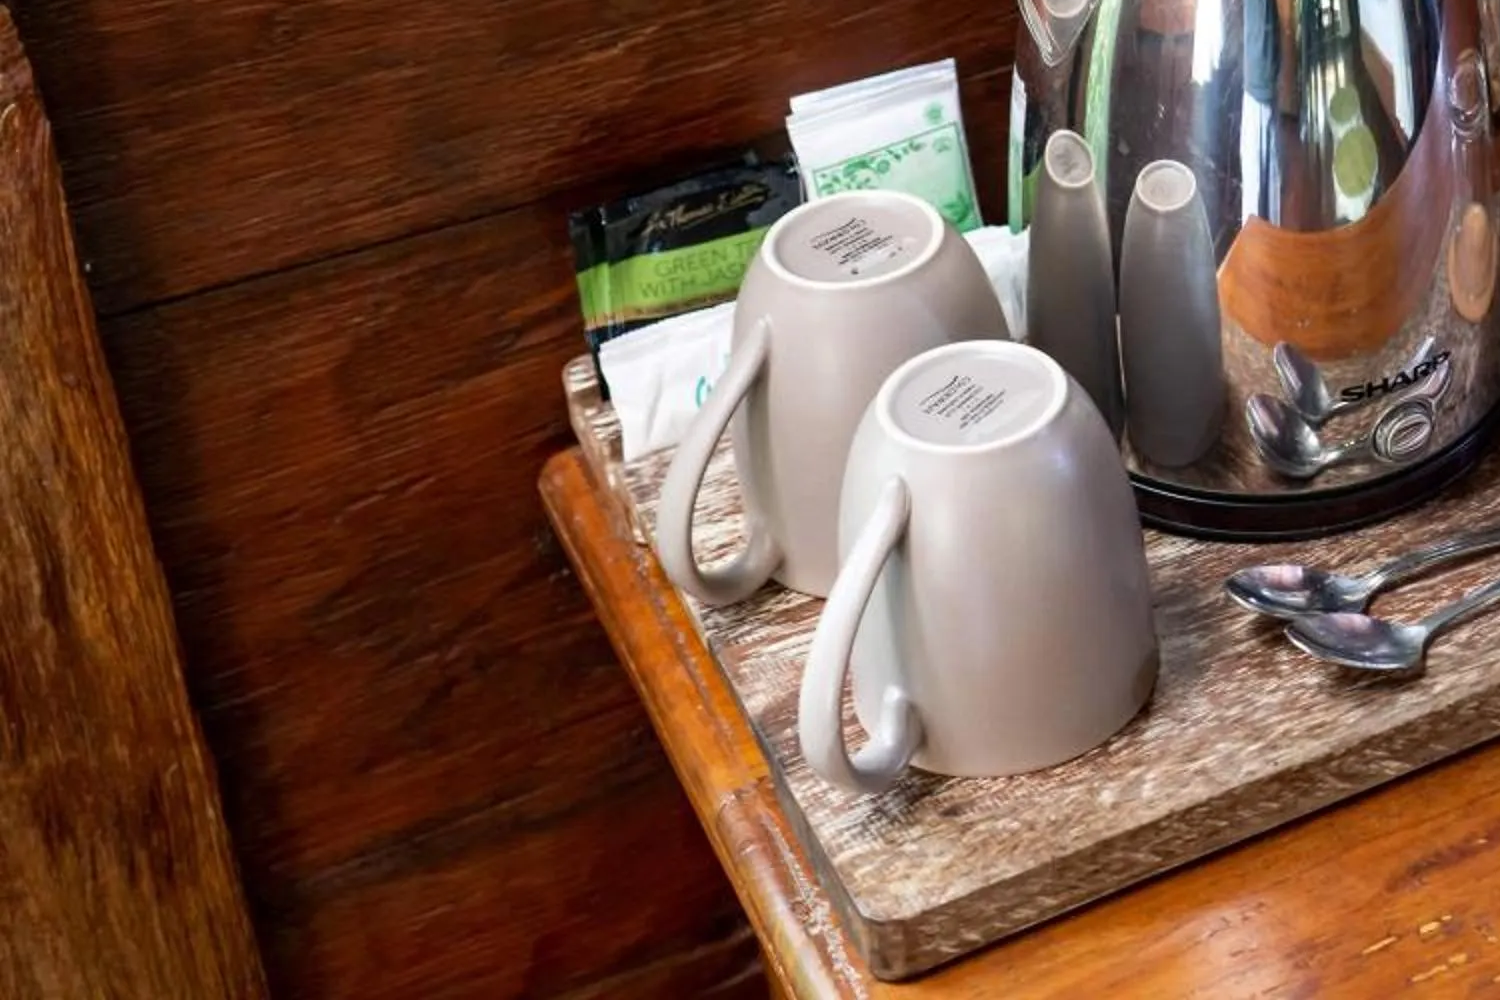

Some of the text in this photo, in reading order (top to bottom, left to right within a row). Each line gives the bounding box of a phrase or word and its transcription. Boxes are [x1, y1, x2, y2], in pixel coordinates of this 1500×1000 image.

[655, 245, 728, 278] GREEN
[638, 274, 697, 298] WITH
[1341, 351, 1451, 402] SHARP
